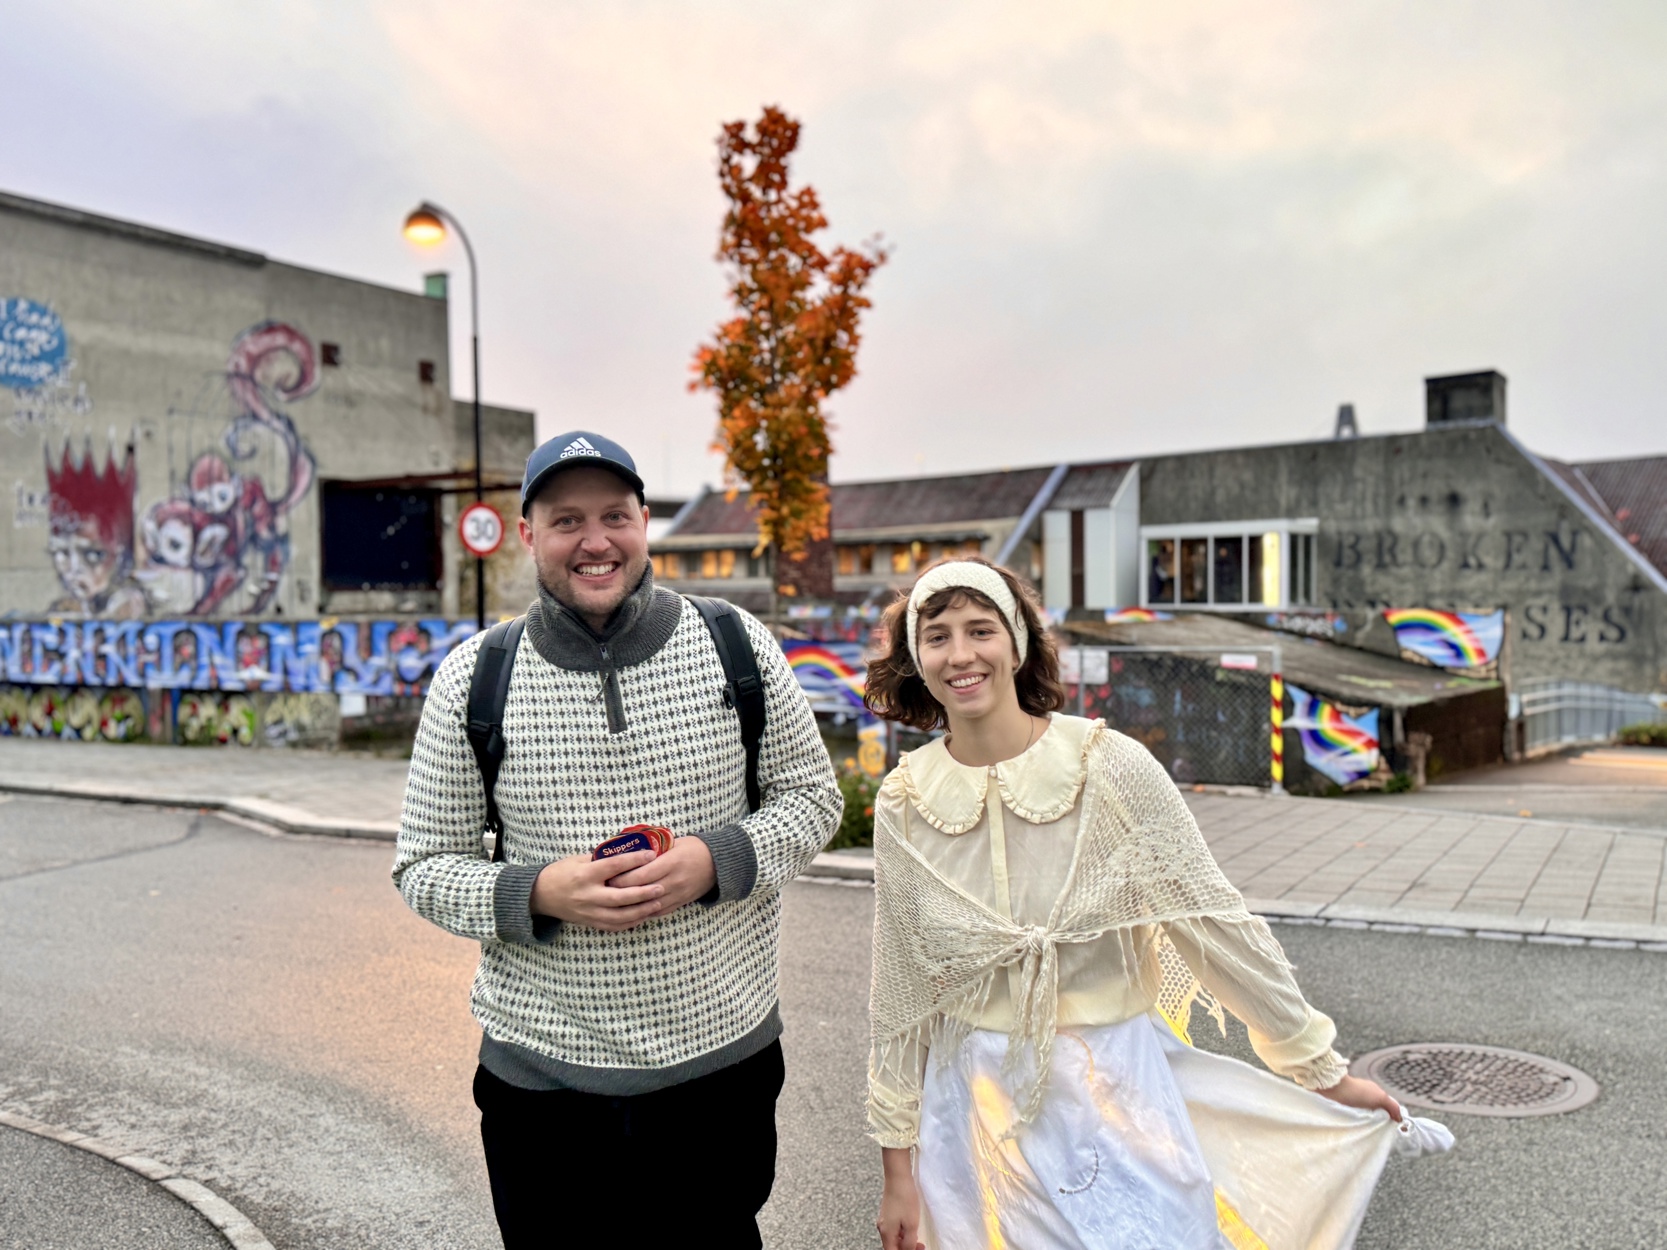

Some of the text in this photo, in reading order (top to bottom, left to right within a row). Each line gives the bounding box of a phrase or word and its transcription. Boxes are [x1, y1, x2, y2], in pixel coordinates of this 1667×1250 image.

[560, 448, 602, 459] adidas
[469, 516, 498, 542] 30
[1332, 529, 1581, 571] BROKEN
[602, 838, 640, 856] Skippers
